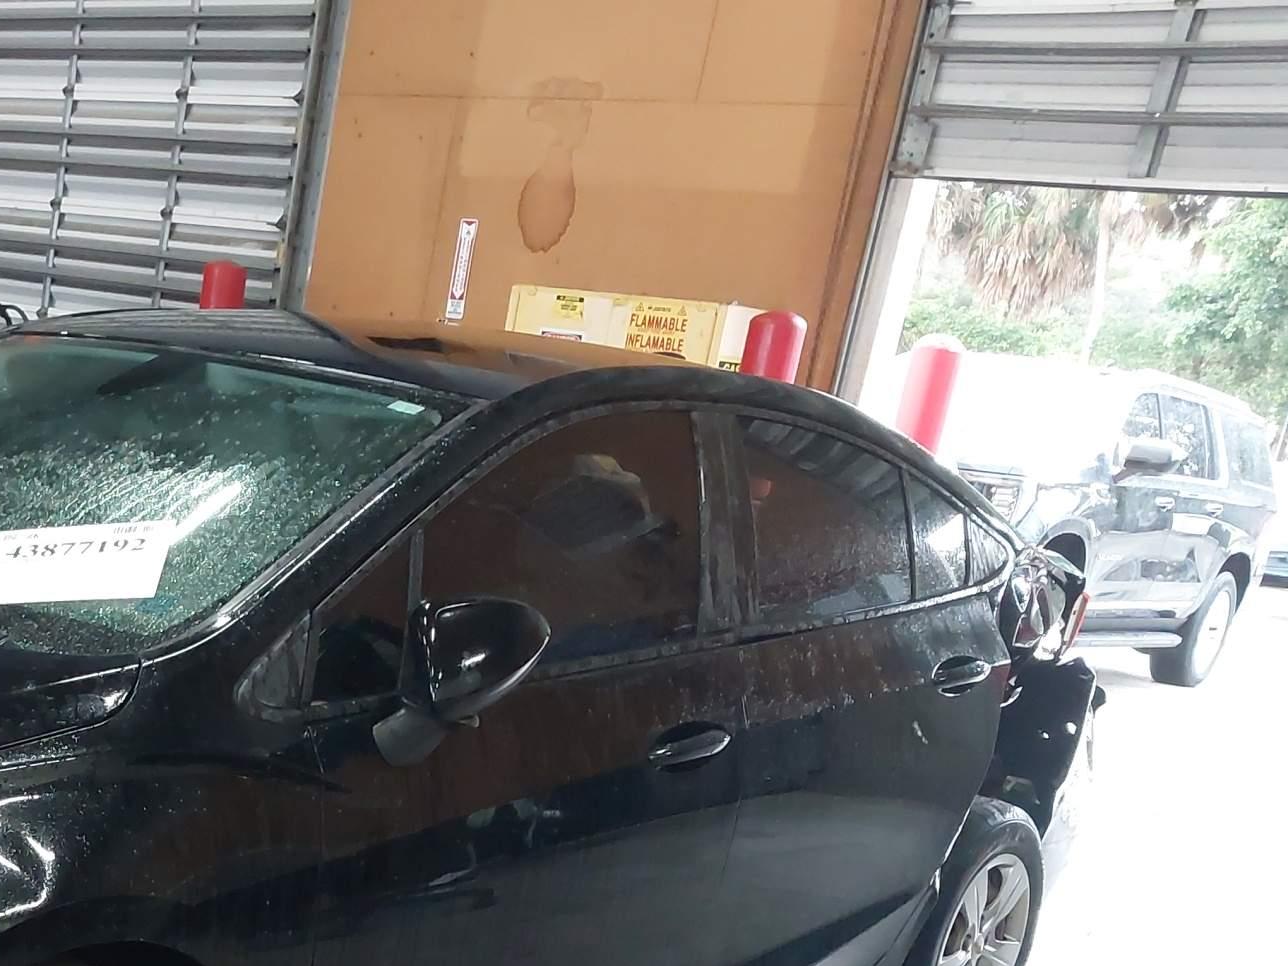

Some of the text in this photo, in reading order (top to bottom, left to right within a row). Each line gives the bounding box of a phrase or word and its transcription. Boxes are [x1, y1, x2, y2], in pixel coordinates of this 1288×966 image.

[629, 312, 689, 333] FLAMMABLE
[624, 332, 685, 353] INFLAMABLE
[4, 537, 147, 559] 43877192
